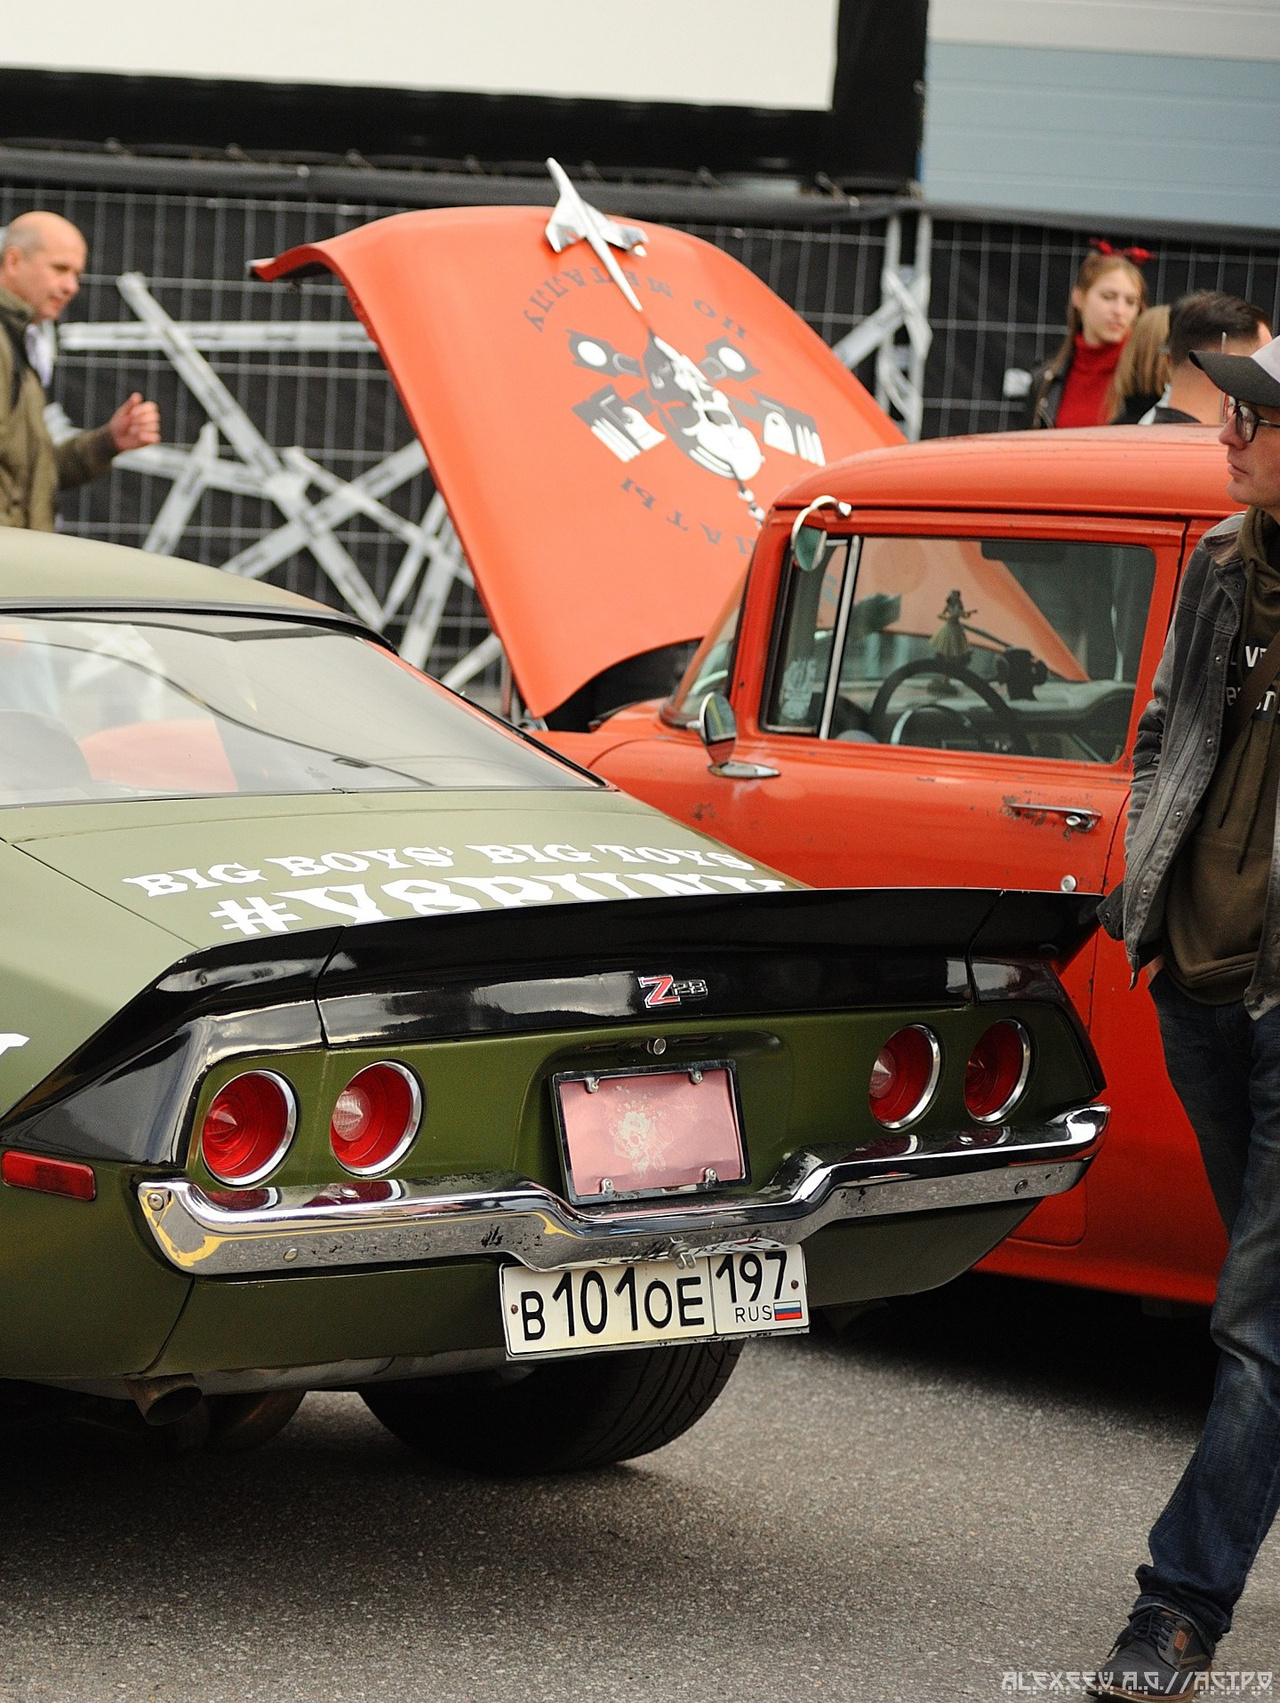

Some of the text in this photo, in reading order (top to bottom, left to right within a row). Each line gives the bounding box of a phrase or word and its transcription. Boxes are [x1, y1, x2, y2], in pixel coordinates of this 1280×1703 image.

[121, 842, 756, 898] BIG BOYS' BIG TOYS
[638, 974, 709, 1009] Z28
[715, 1250, 788, 1304] 197
[734, 1305, 773, 1324] RUS
